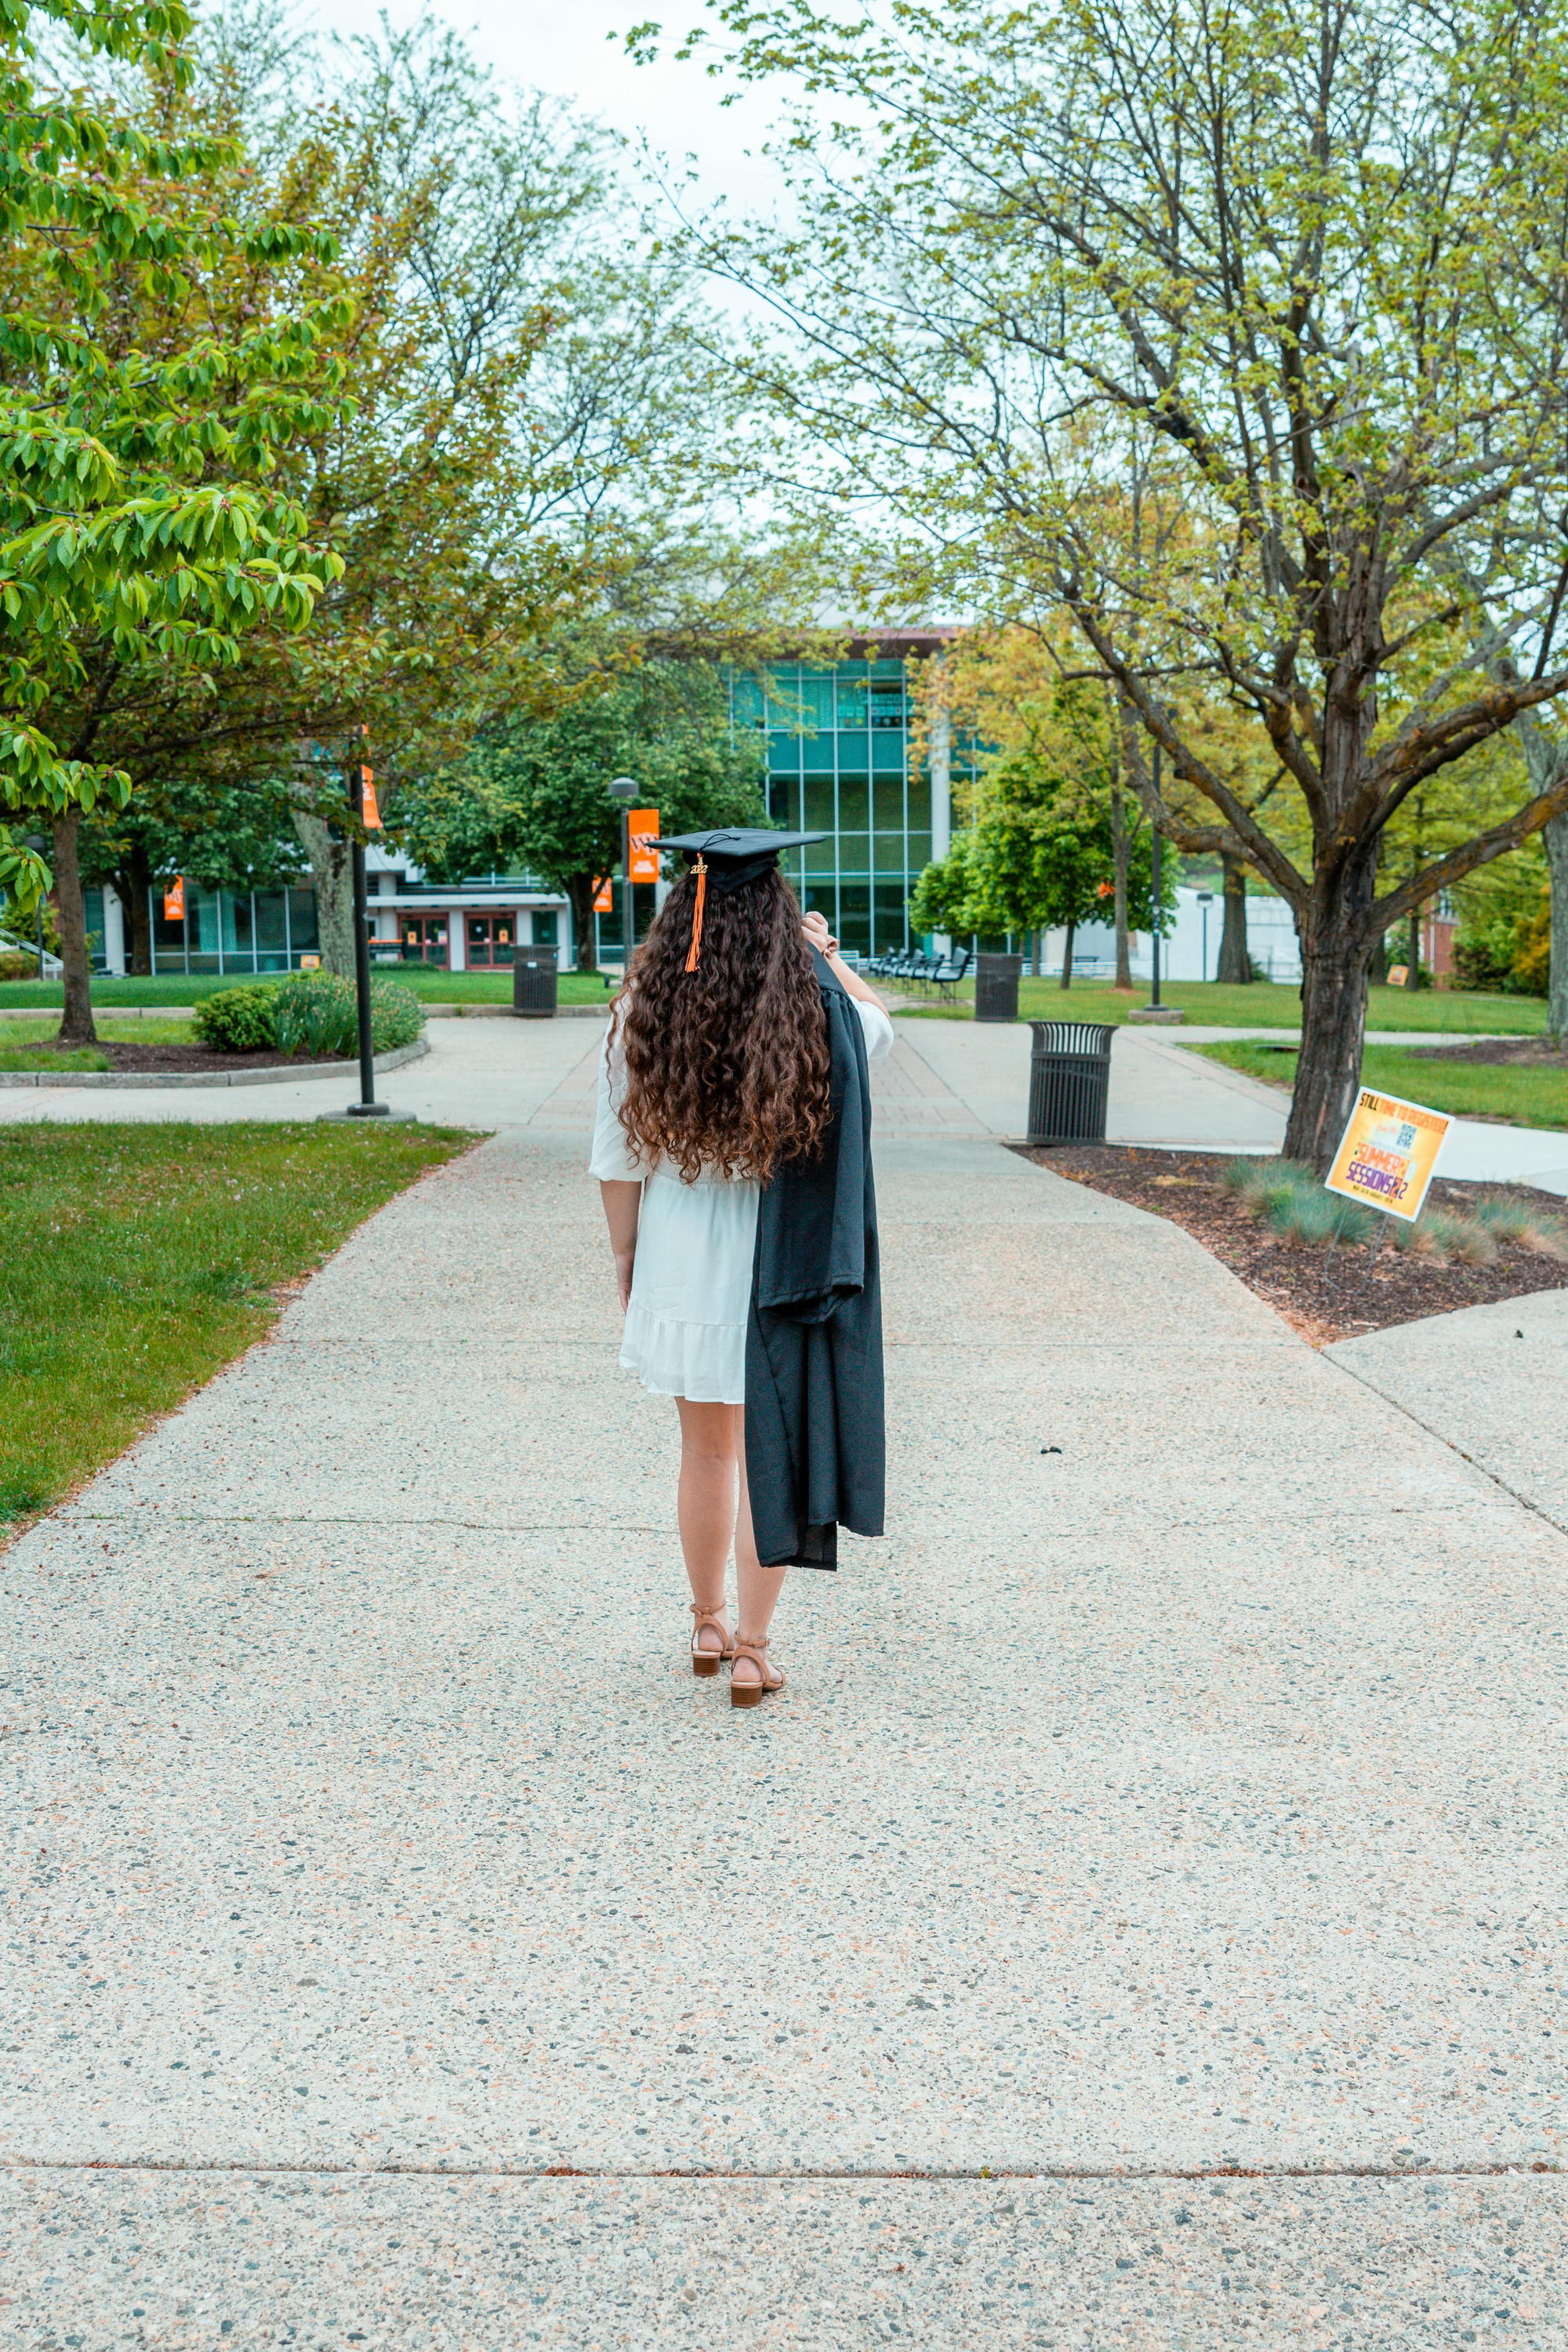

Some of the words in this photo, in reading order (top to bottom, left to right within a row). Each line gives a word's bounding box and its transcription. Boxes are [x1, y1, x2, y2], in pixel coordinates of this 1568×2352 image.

[690, 864, 708, 874] 2022
[1359, 1093, 1379, 1110] STILL
[1378, 1098, 1398, 1116] TIME
[1397, 1105, 1410, 1120] TO
[1406, 1109, 1449, 1134] REGISTER!
[1357, 1143, 1401, 1174] SUMMER
[1346, 1161, 1393, 1194] SESSIONS
